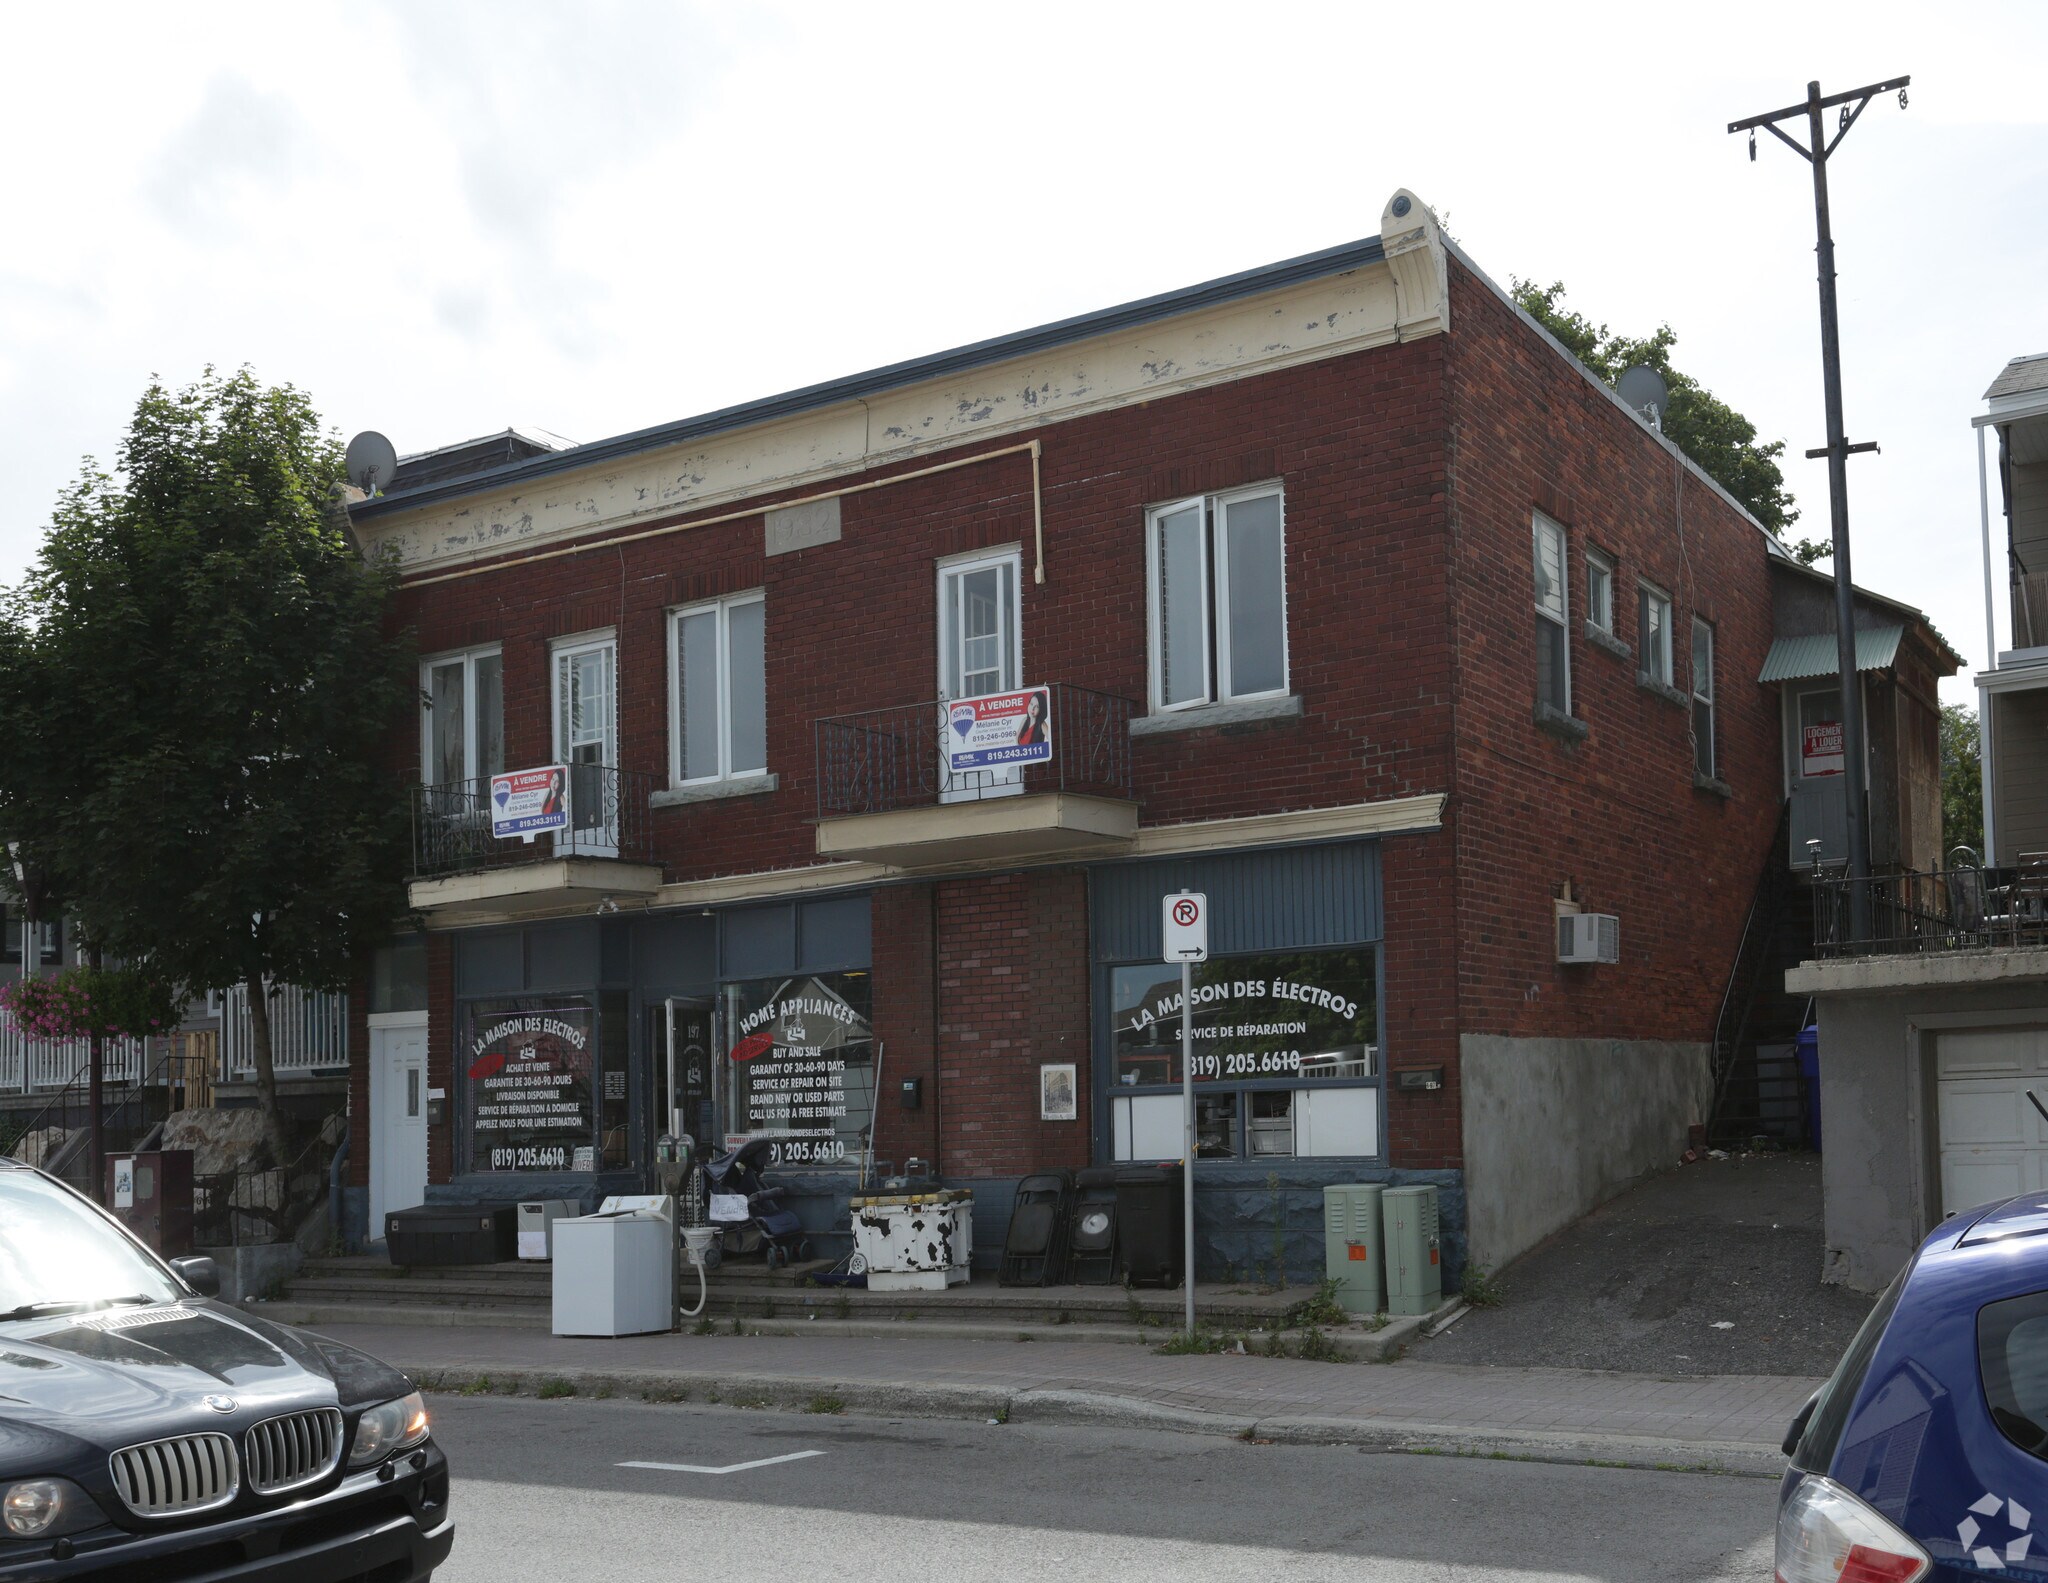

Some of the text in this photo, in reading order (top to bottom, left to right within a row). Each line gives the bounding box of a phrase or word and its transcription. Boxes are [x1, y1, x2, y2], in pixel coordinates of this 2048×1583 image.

[979, 697, 1024, 712] À VENDRE
[976, 718, 1012, 729] Mélanie Cyr
[972, 730, 1017, 743] 819-246-0969
[1819, 736, 1842, 746] LOUER
[987, 746, 1043, 761] 819.243.3111
[520, 774, 548, 784] VENDRE
[519, 815, 561, 828] 819.243.3111
[1131, 977, 1358, 1032] LA MASON DES ÉLECTROS
[740, 998, 855, 1034] HOME APPLIANCES
[472, 1017, 586, 1056] LA MAISON DES ELECTROS
[688, 1026, 700, 1038] 197
[1220, 1026, 1234, 1038] DE
[1236, 1022, 1306, 1036] RÉPARATION
[772, 1046, 821, 1058] BUY AND SALE
[506, 1062, 550, 1073] ACHAT ET VENTE
[750, 1061, 845, 1076] GARANTY OF 30-60-90 DAYS
[1226, 1050, 1300, 1074] 205.6610
[484, 1075, 572, 1088] GARANTIE DE 30-60-90 JOURS
[752, 1076, 842, 1090] SERVICE OF REPAIR ON SITE
[496, 1090, 560, 1101] LIVRAISON DISPONIBLE
[750, 1090, 844, 1105] BRAND NEW OR USED PARTS
[478, 1106, 500, 1115] SERVICE
[500, 1105, 508, 1114] DE
[546, 1104, 552, 1113] A
[552, 1102, 579, 1113] DOMICILE
[750, 1106, 846, 1120] CALL US FOR A FREE ESTIMATE
[476, 1116, 582, 1129] APPELEZ NOUS POUR UNE ESTIMATION
[786, 1140, 844, 1161] 205.6610
[491, 1147, 564, 1170] (819) 205.6610
